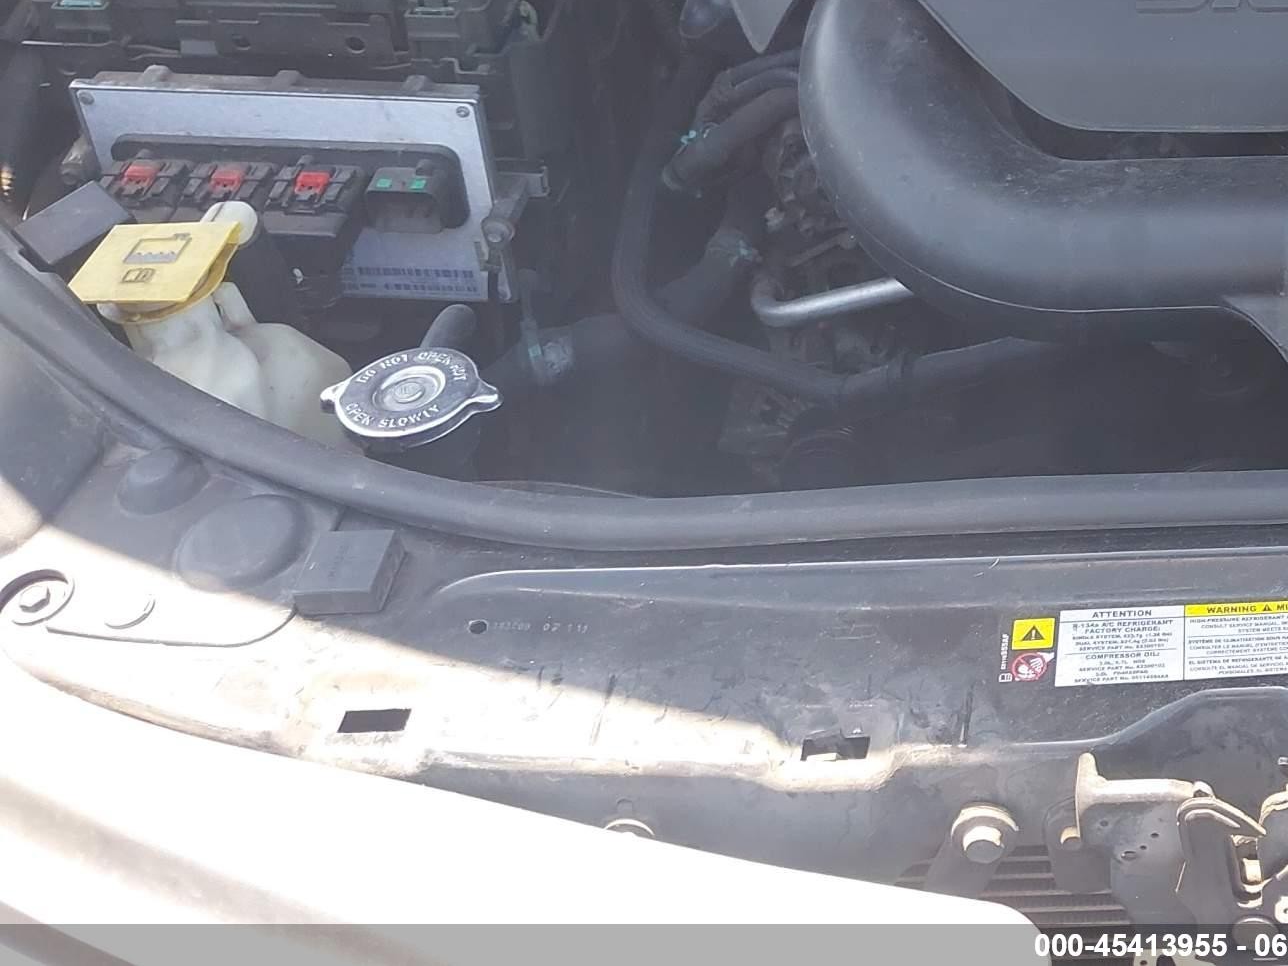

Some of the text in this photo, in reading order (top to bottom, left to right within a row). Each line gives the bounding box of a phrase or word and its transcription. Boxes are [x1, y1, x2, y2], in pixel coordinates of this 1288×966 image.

[380, 354, 409, 370] NOT
[417, 350, 451, 366] OPEN
[345, 402, 441, 428] OPEN SLOWLY
[1207, 605, 1256, 614] WARNING
[1092, 610, 1152, 619] ATTENTION
[1085, 652, 1141, 660] COMPRESSOR
